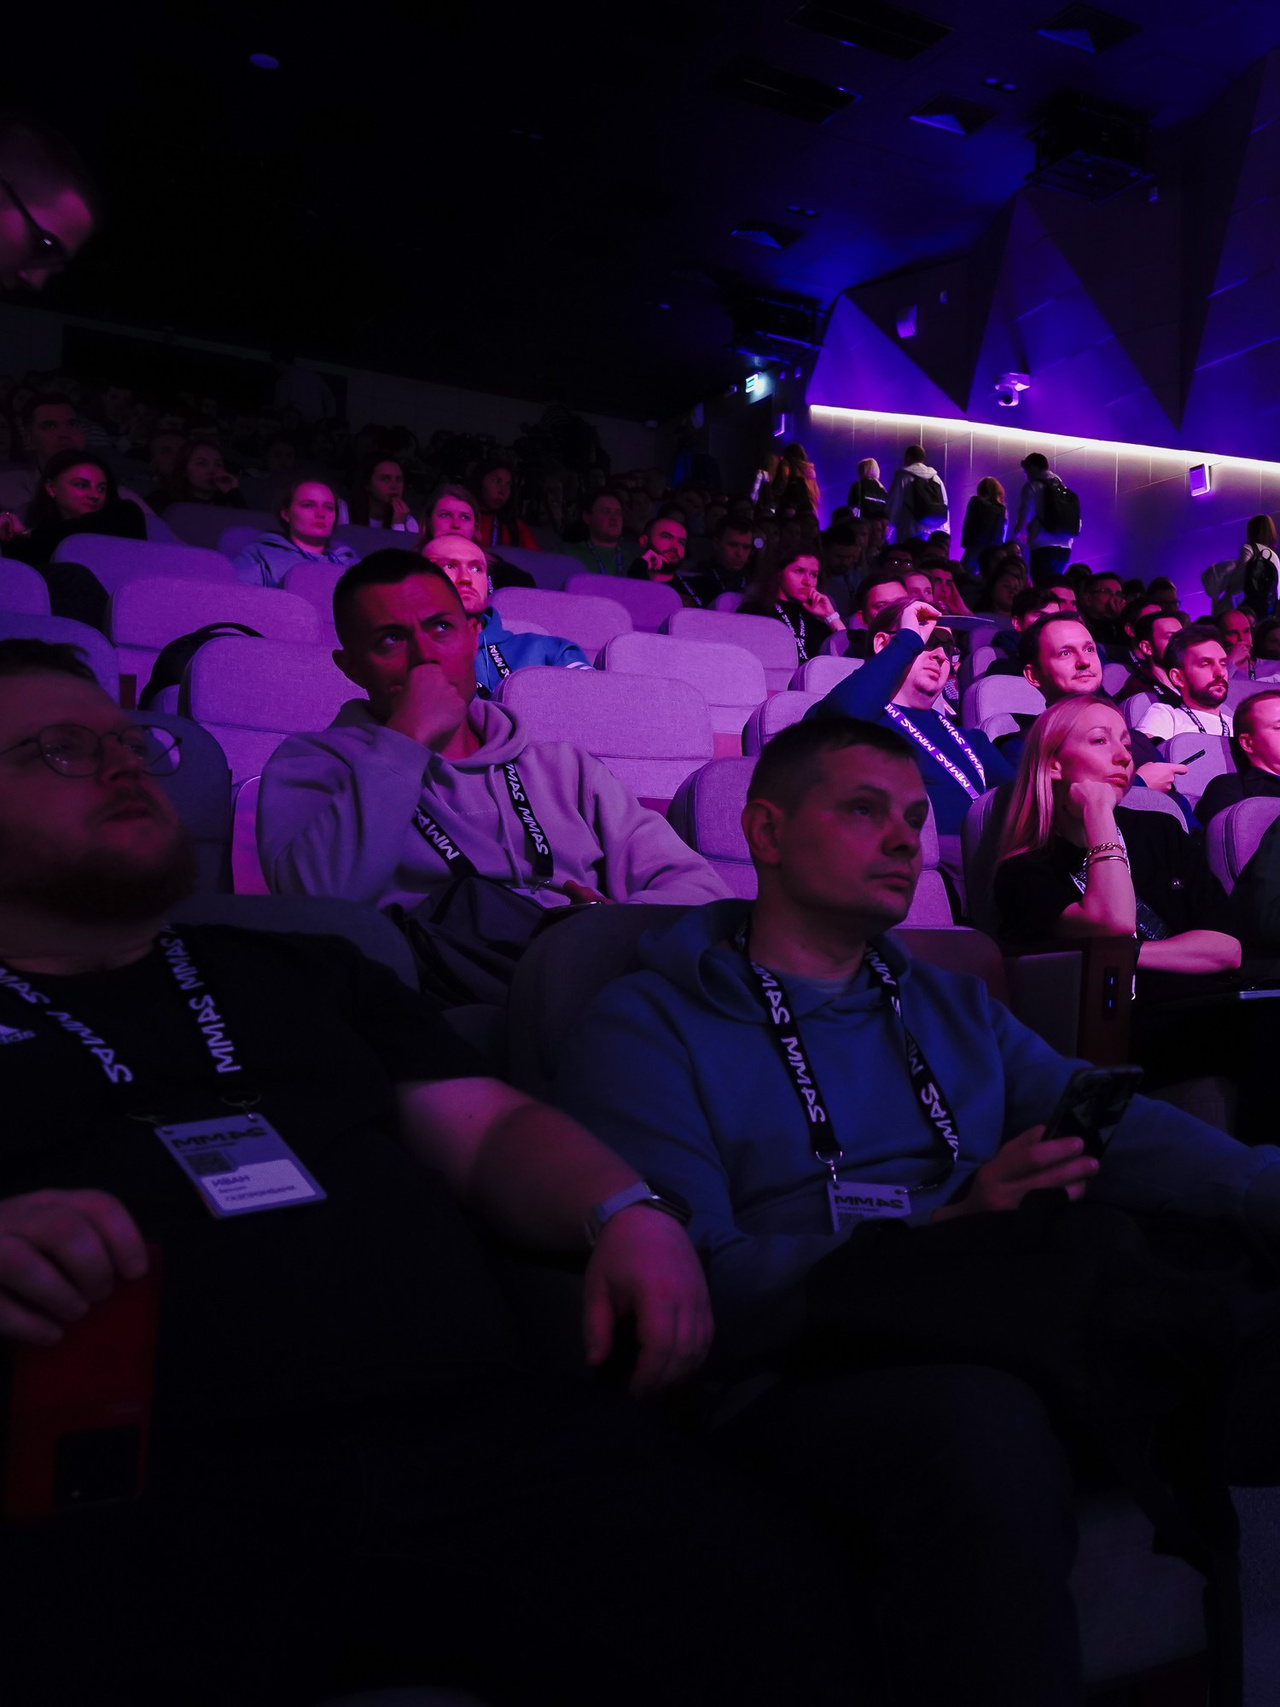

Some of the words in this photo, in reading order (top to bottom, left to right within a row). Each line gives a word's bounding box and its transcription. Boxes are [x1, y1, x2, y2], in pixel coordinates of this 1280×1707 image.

[518, 806, 549, 855] MMAS
[0, 966, 52, 1004] MAS
[158, 936, 207, 991] MMAS
[45, 1010, 134, 1084] MMAS
[187, 993, 243, 1075] MMAS
[780, 1036, 827, 1124] MMAS
[834, 1195, 904, 1209] MMAS
